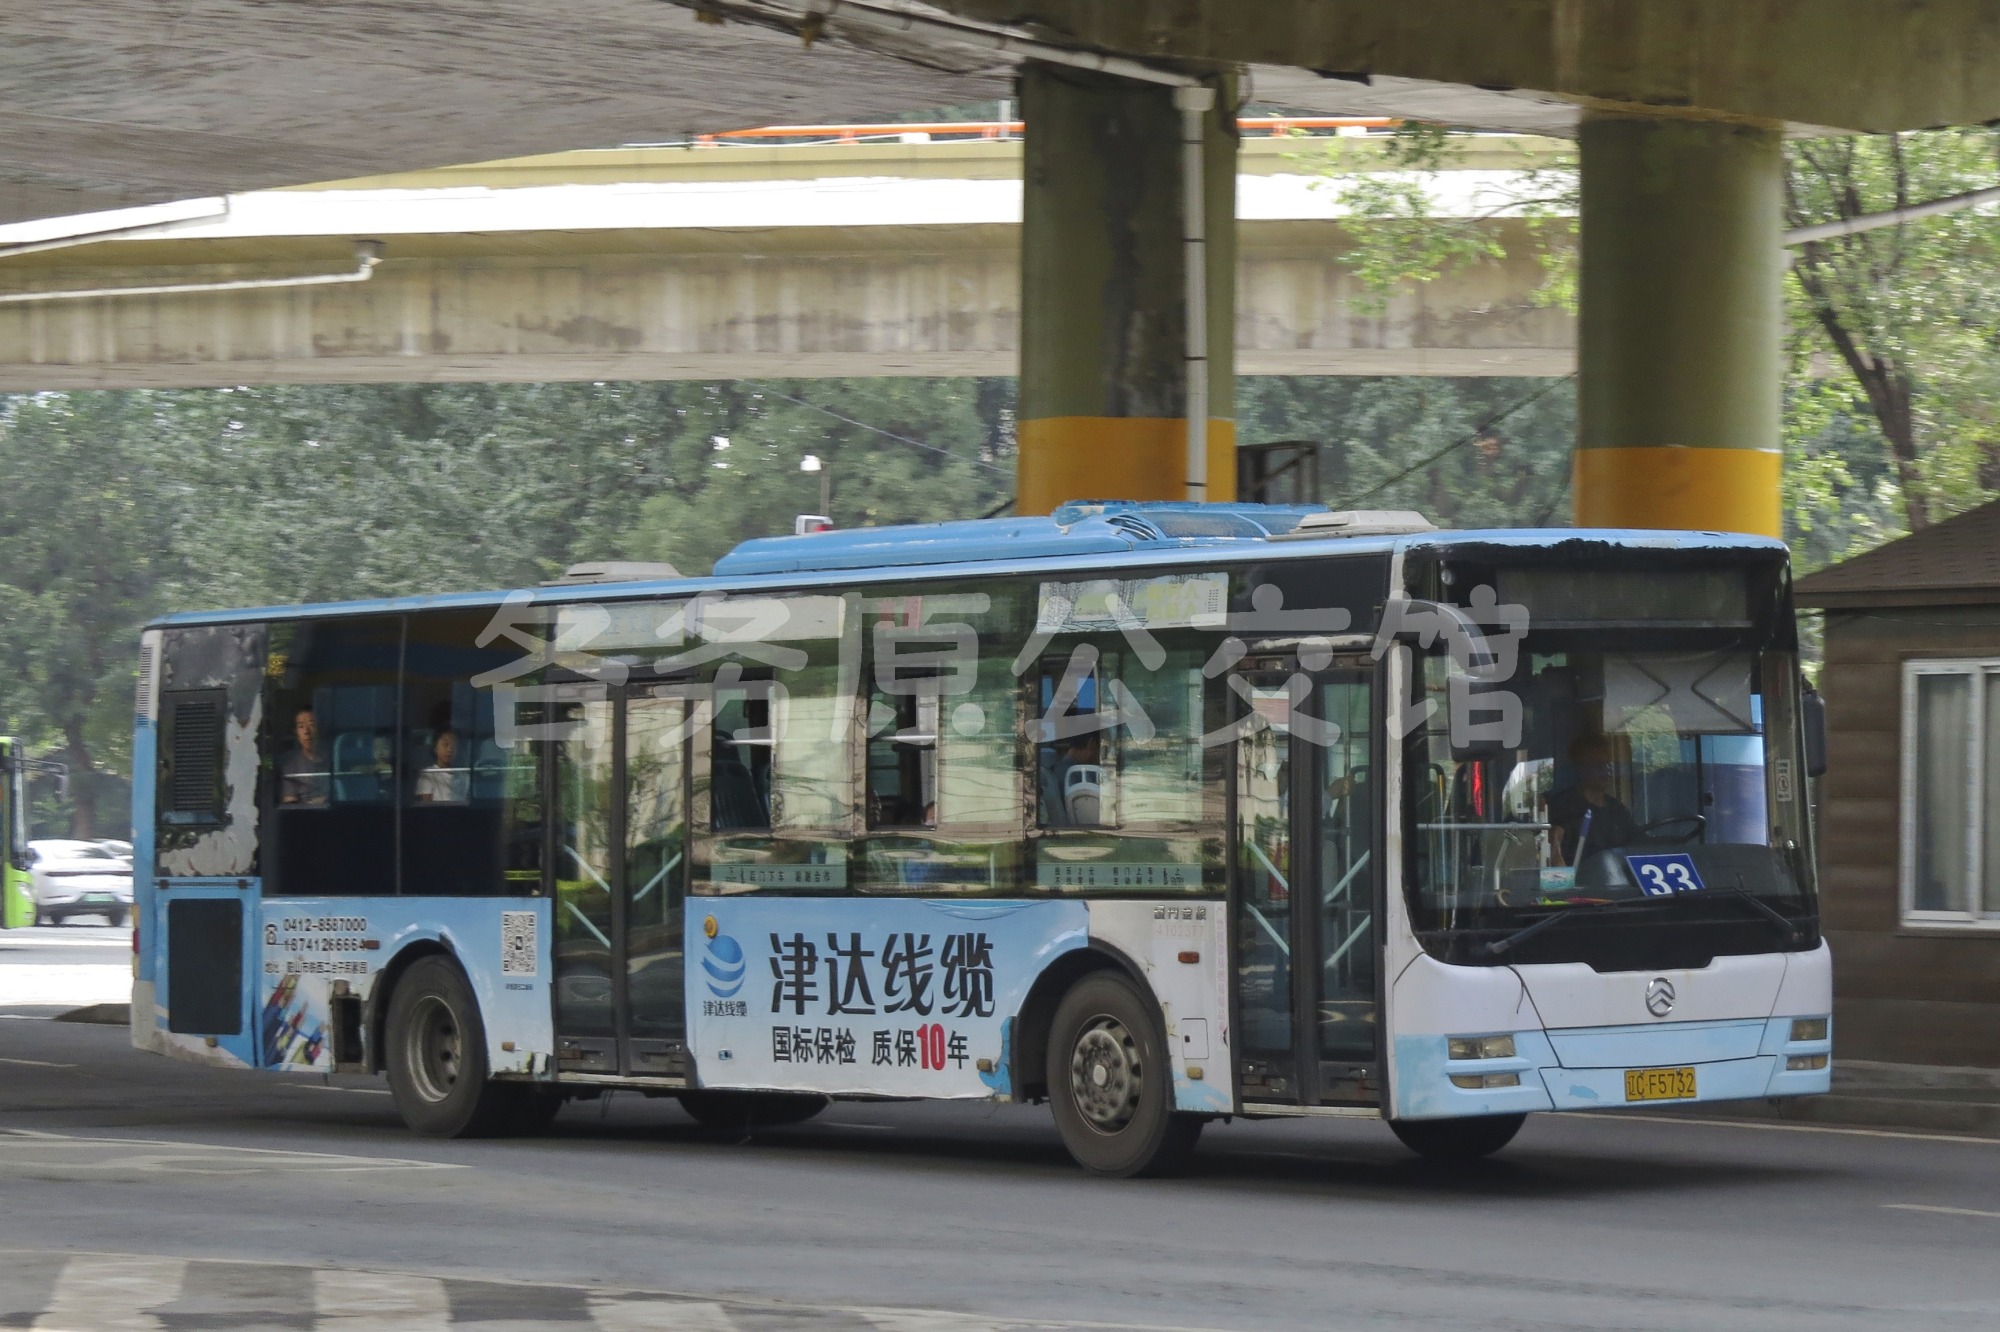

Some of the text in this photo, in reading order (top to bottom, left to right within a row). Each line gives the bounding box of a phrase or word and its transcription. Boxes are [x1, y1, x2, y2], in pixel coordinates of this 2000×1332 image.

[1641, 863, 1698, 896] 33
[769, 932, 995, 1018] 津达线缆
[703, 1000, 748, 1017] 津达线缆
[772, 1022, 970, 1071] 国标保检 质保10年
